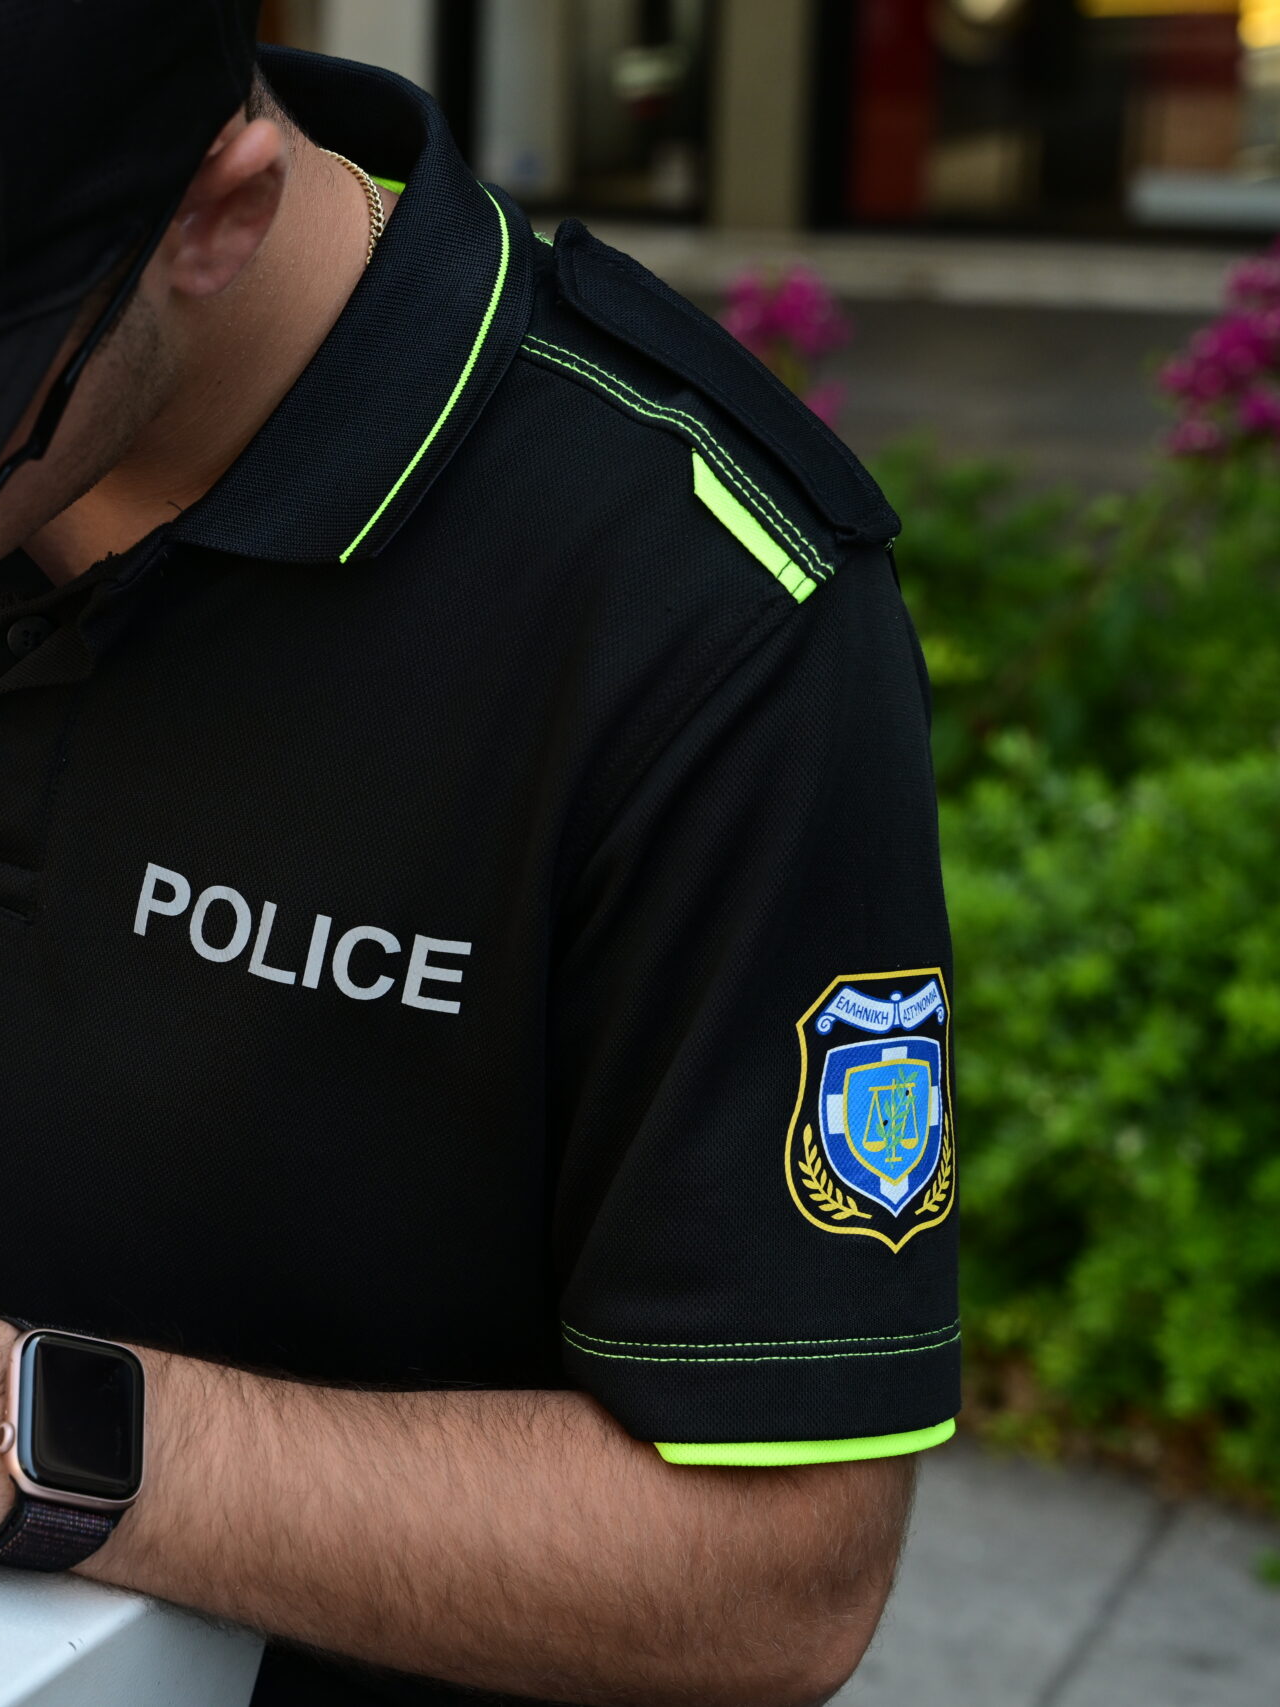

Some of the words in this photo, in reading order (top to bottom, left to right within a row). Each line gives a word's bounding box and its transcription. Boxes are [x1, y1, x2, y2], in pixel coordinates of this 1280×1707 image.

[133, 862, 472, 1015] POLICE
[836, 996, 889, 1025] ΕΛΛΗΝΙΚΗ
[903, 988, 938, 1022] ΑΣΤΥΝΟΜΙΑ
